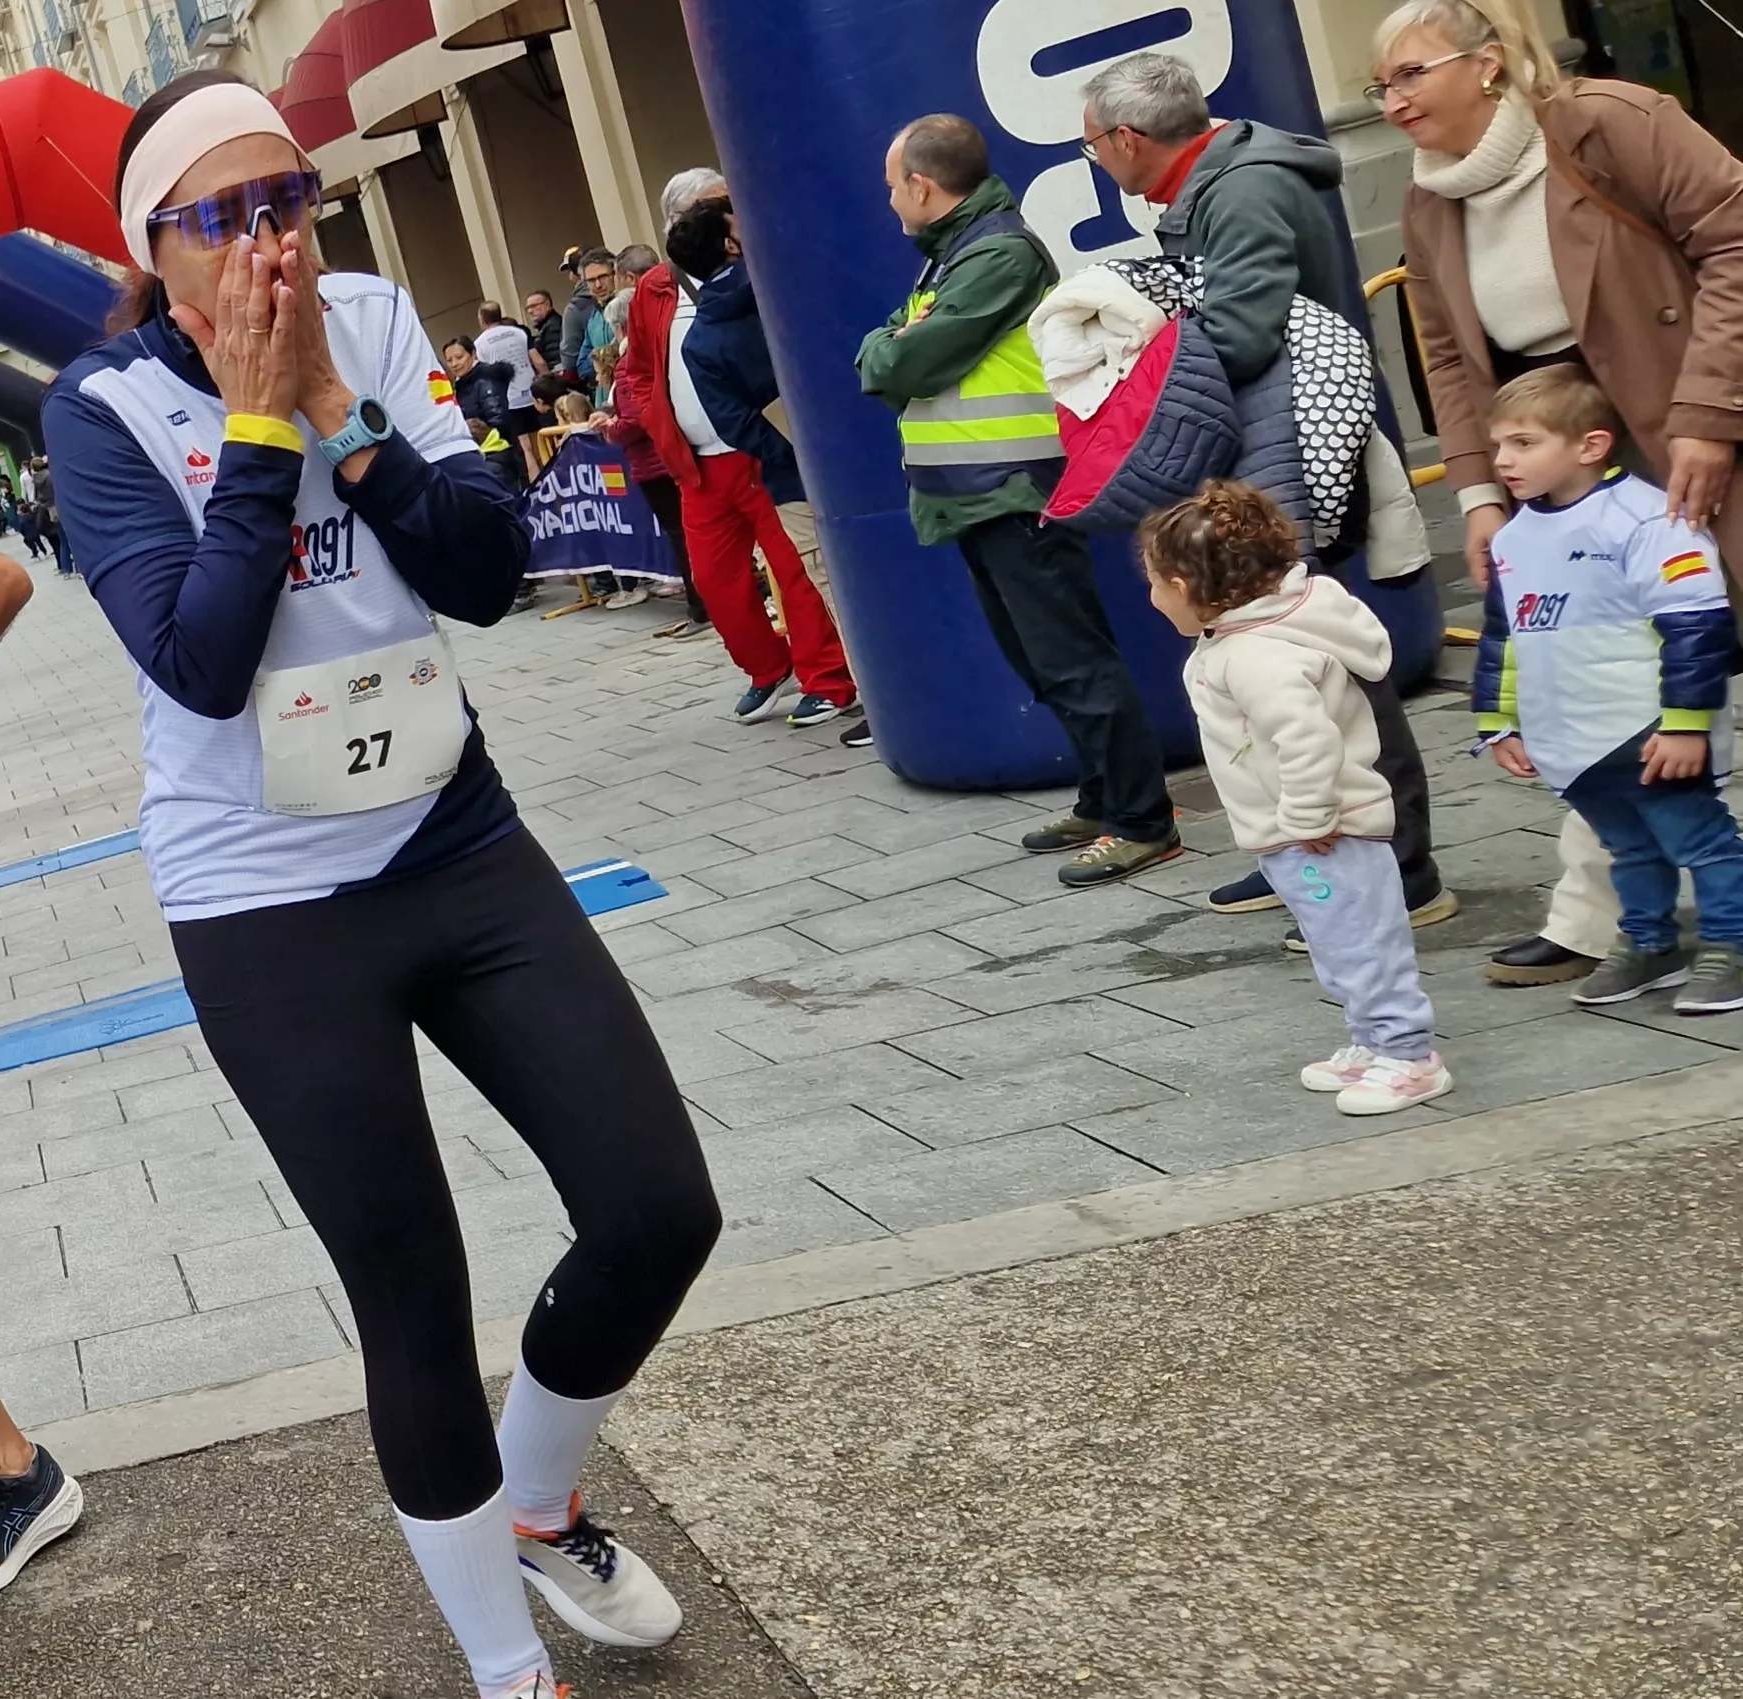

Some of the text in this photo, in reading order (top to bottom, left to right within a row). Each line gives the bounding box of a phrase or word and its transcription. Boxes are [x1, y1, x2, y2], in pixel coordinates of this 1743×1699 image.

[527, 500, 634, 542] NACIONAL
[278, 704, 330, 721] Santander
[346, 730, 393, 776] 27
[1302, 864, 1334, 902] S
